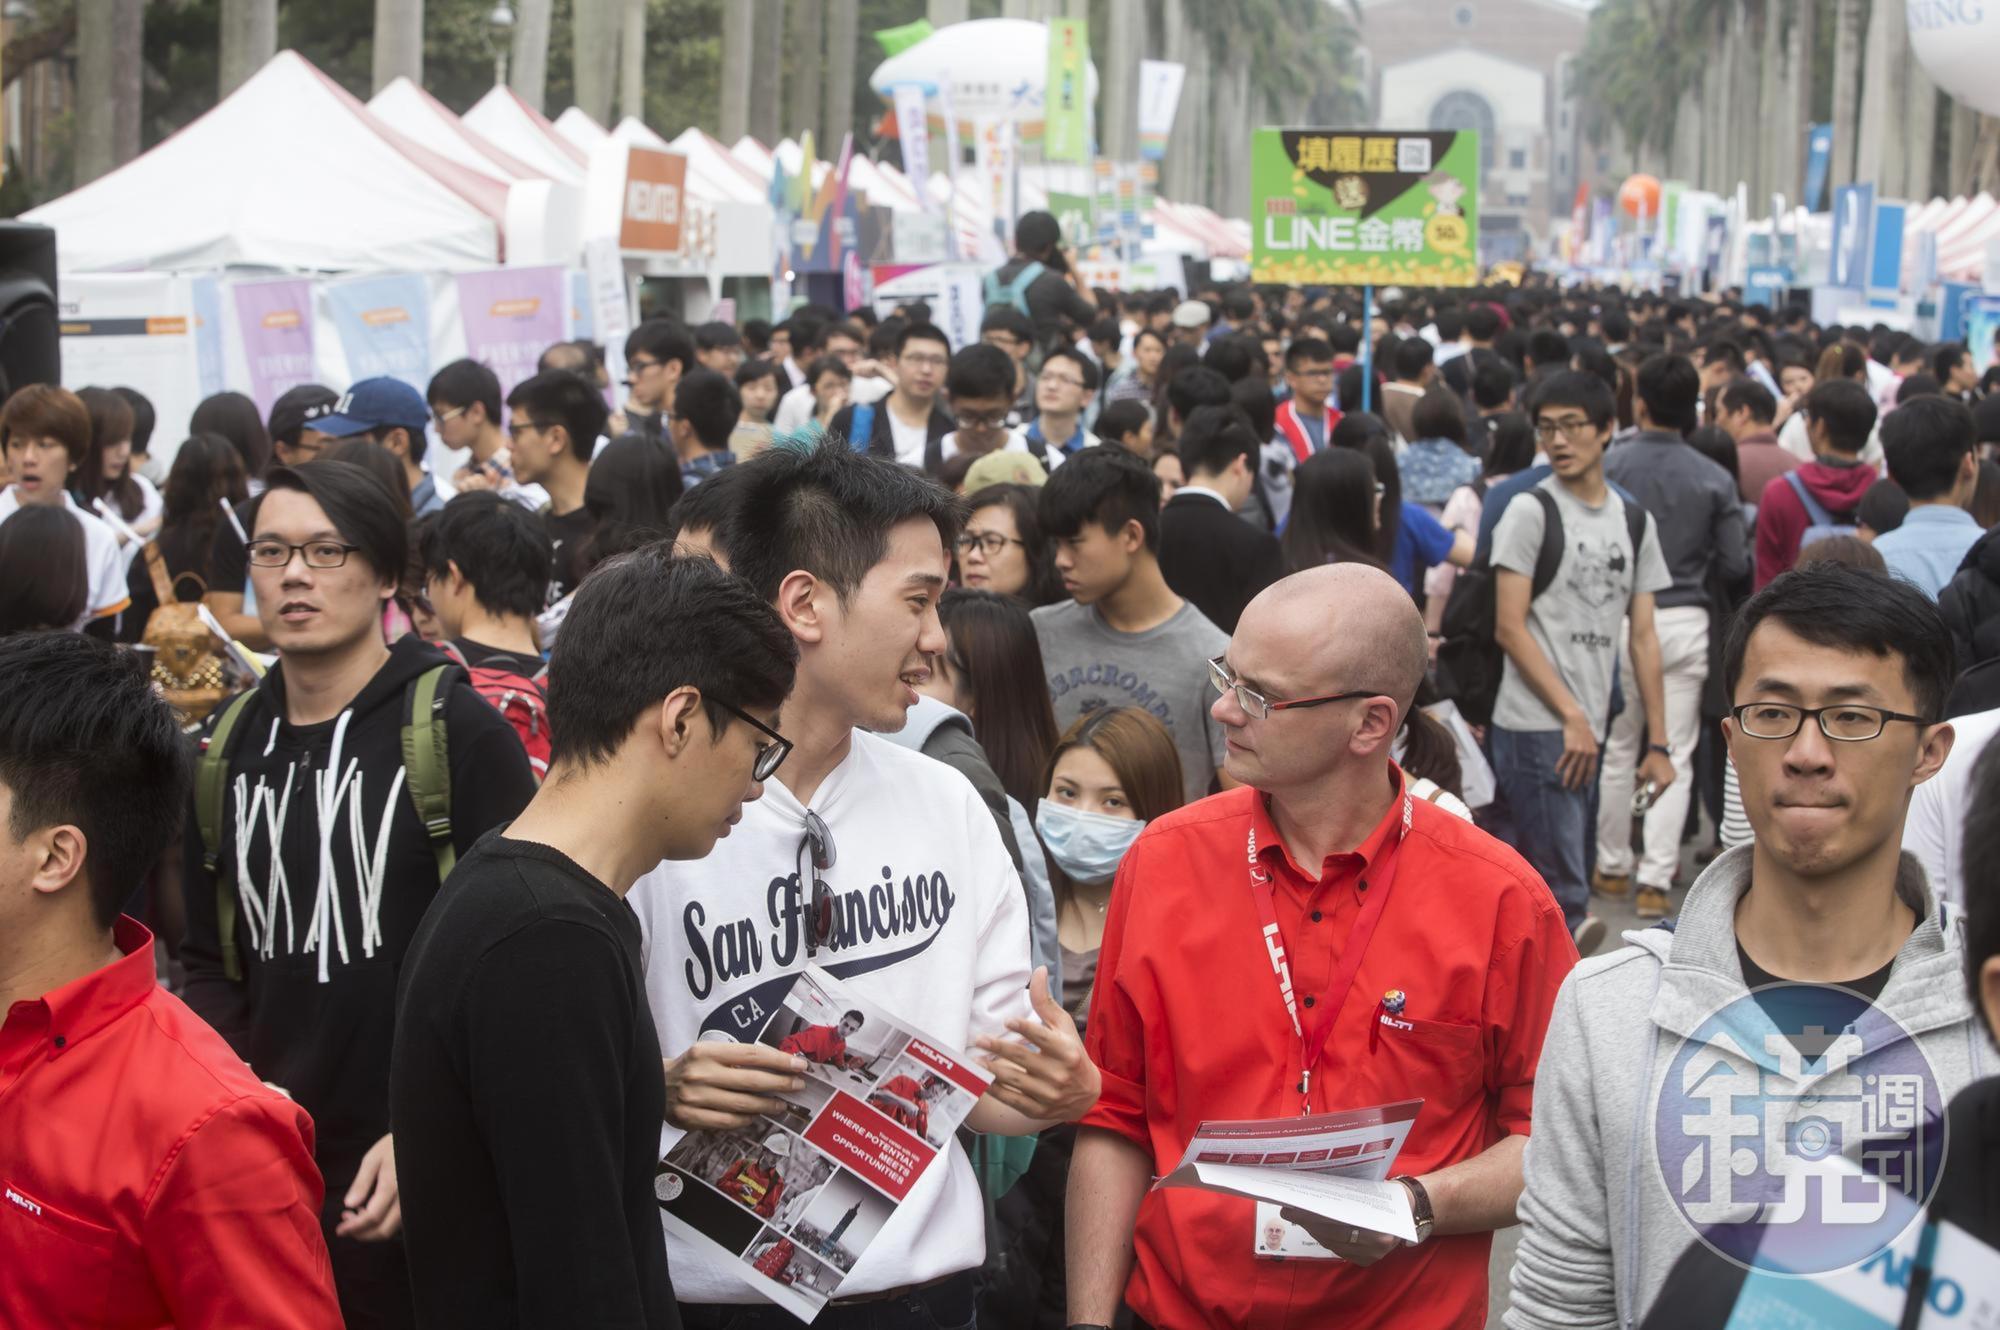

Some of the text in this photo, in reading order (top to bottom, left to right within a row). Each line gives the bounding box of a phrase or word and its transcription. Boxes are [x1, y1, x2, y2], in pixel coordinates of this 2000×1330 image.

[682, 900, 762, 1001] San
[731, 997, 765, 1029] CA
[912, 1041, 954, 1070] HILTI
[832, 1109, 914, 1169] WHERE POTENTIAL
[1227, 1129, 1280, 1138] Management
[831, 1133, 905, 1185] OPPORTUNITIES
[878, 1151, 911, 1177] MEETS
[5, 1188, 41, 1216] HILTI
